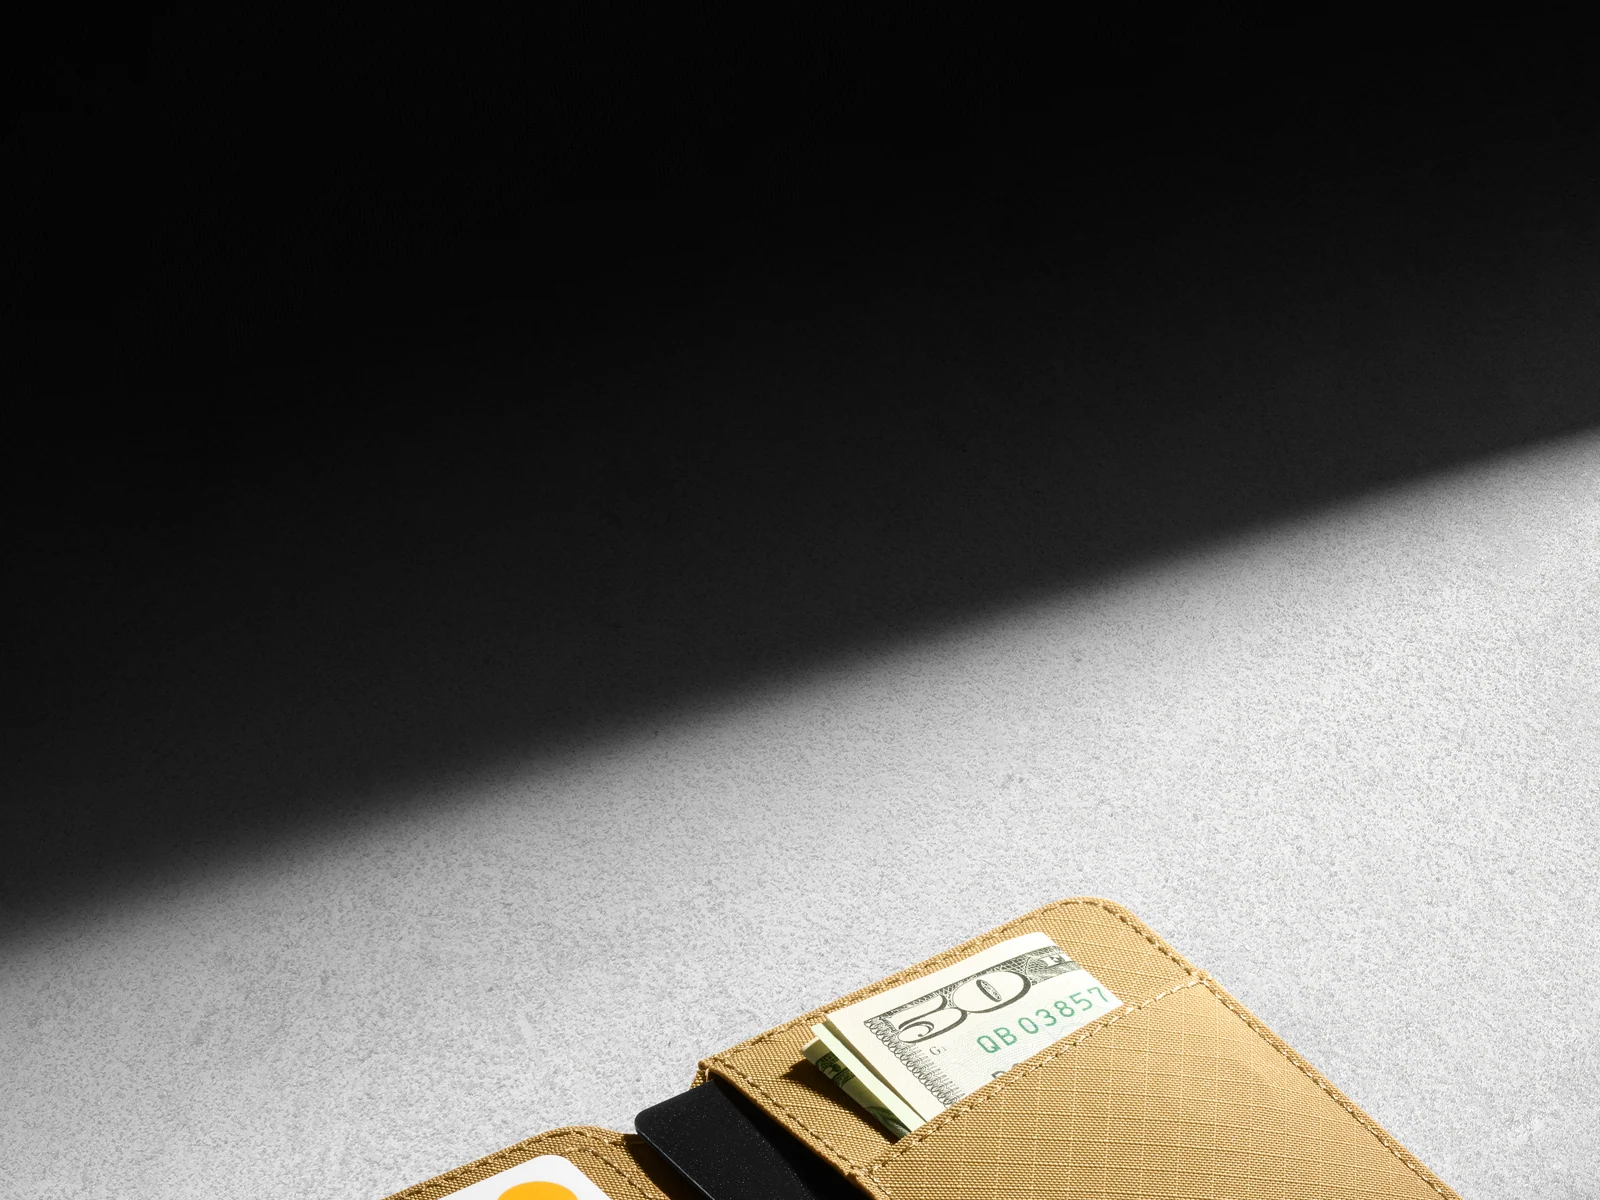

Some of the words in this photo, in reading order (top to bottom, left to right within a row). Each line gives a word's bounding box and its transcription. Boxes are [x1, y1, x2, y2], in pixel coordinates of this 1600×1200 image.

[886, 971, 1031, 1043] 50
[976, 1027, 1018, 1054] QB
[1017, 986, 1109, 1035] 03857
